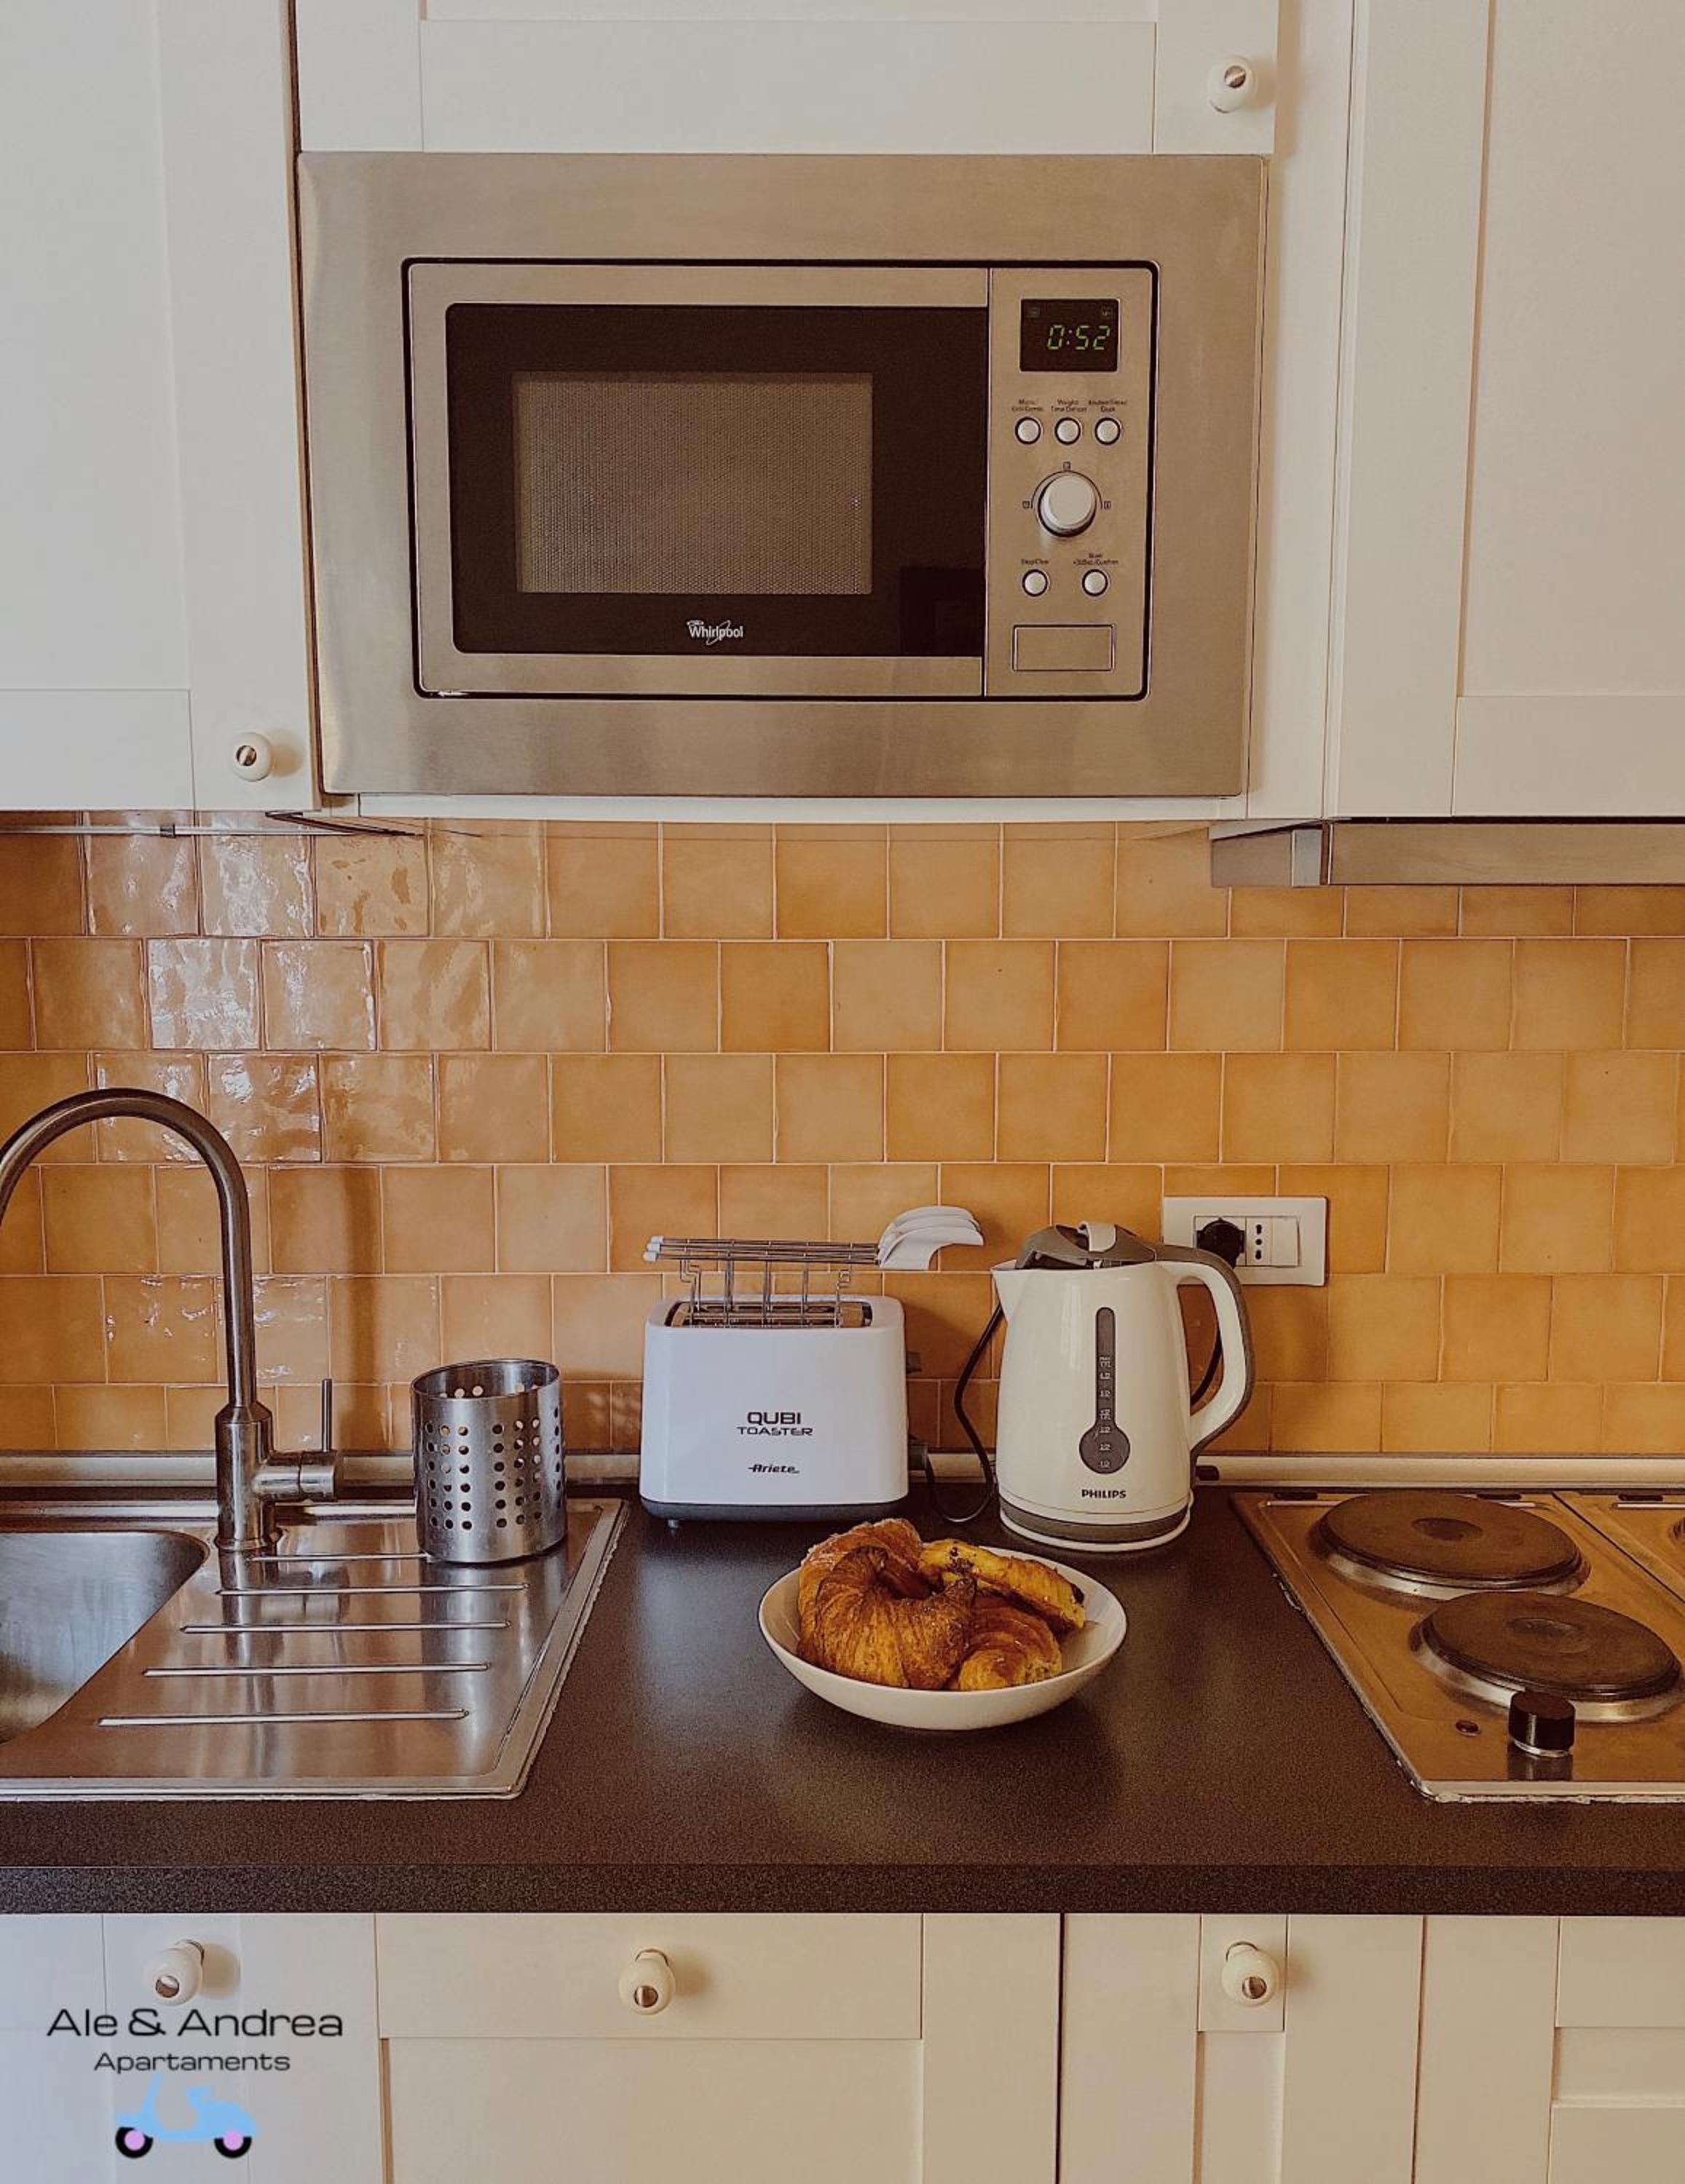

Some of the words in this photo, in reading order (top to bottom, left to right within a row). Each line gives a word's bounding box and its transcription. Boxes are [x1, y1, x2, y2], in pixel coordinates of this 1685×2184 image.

[1046, 325, 1110, 350] 0:52
[687, 622, 743, 643] Whirlpool
[747, 1412, 801, 1425] QUBI
[736, 1426, 813, 1436] TOASTER
[747, 1463, 800, 1474] Ariete
[1081, 1489, 1126, 1499] PHILIPS
